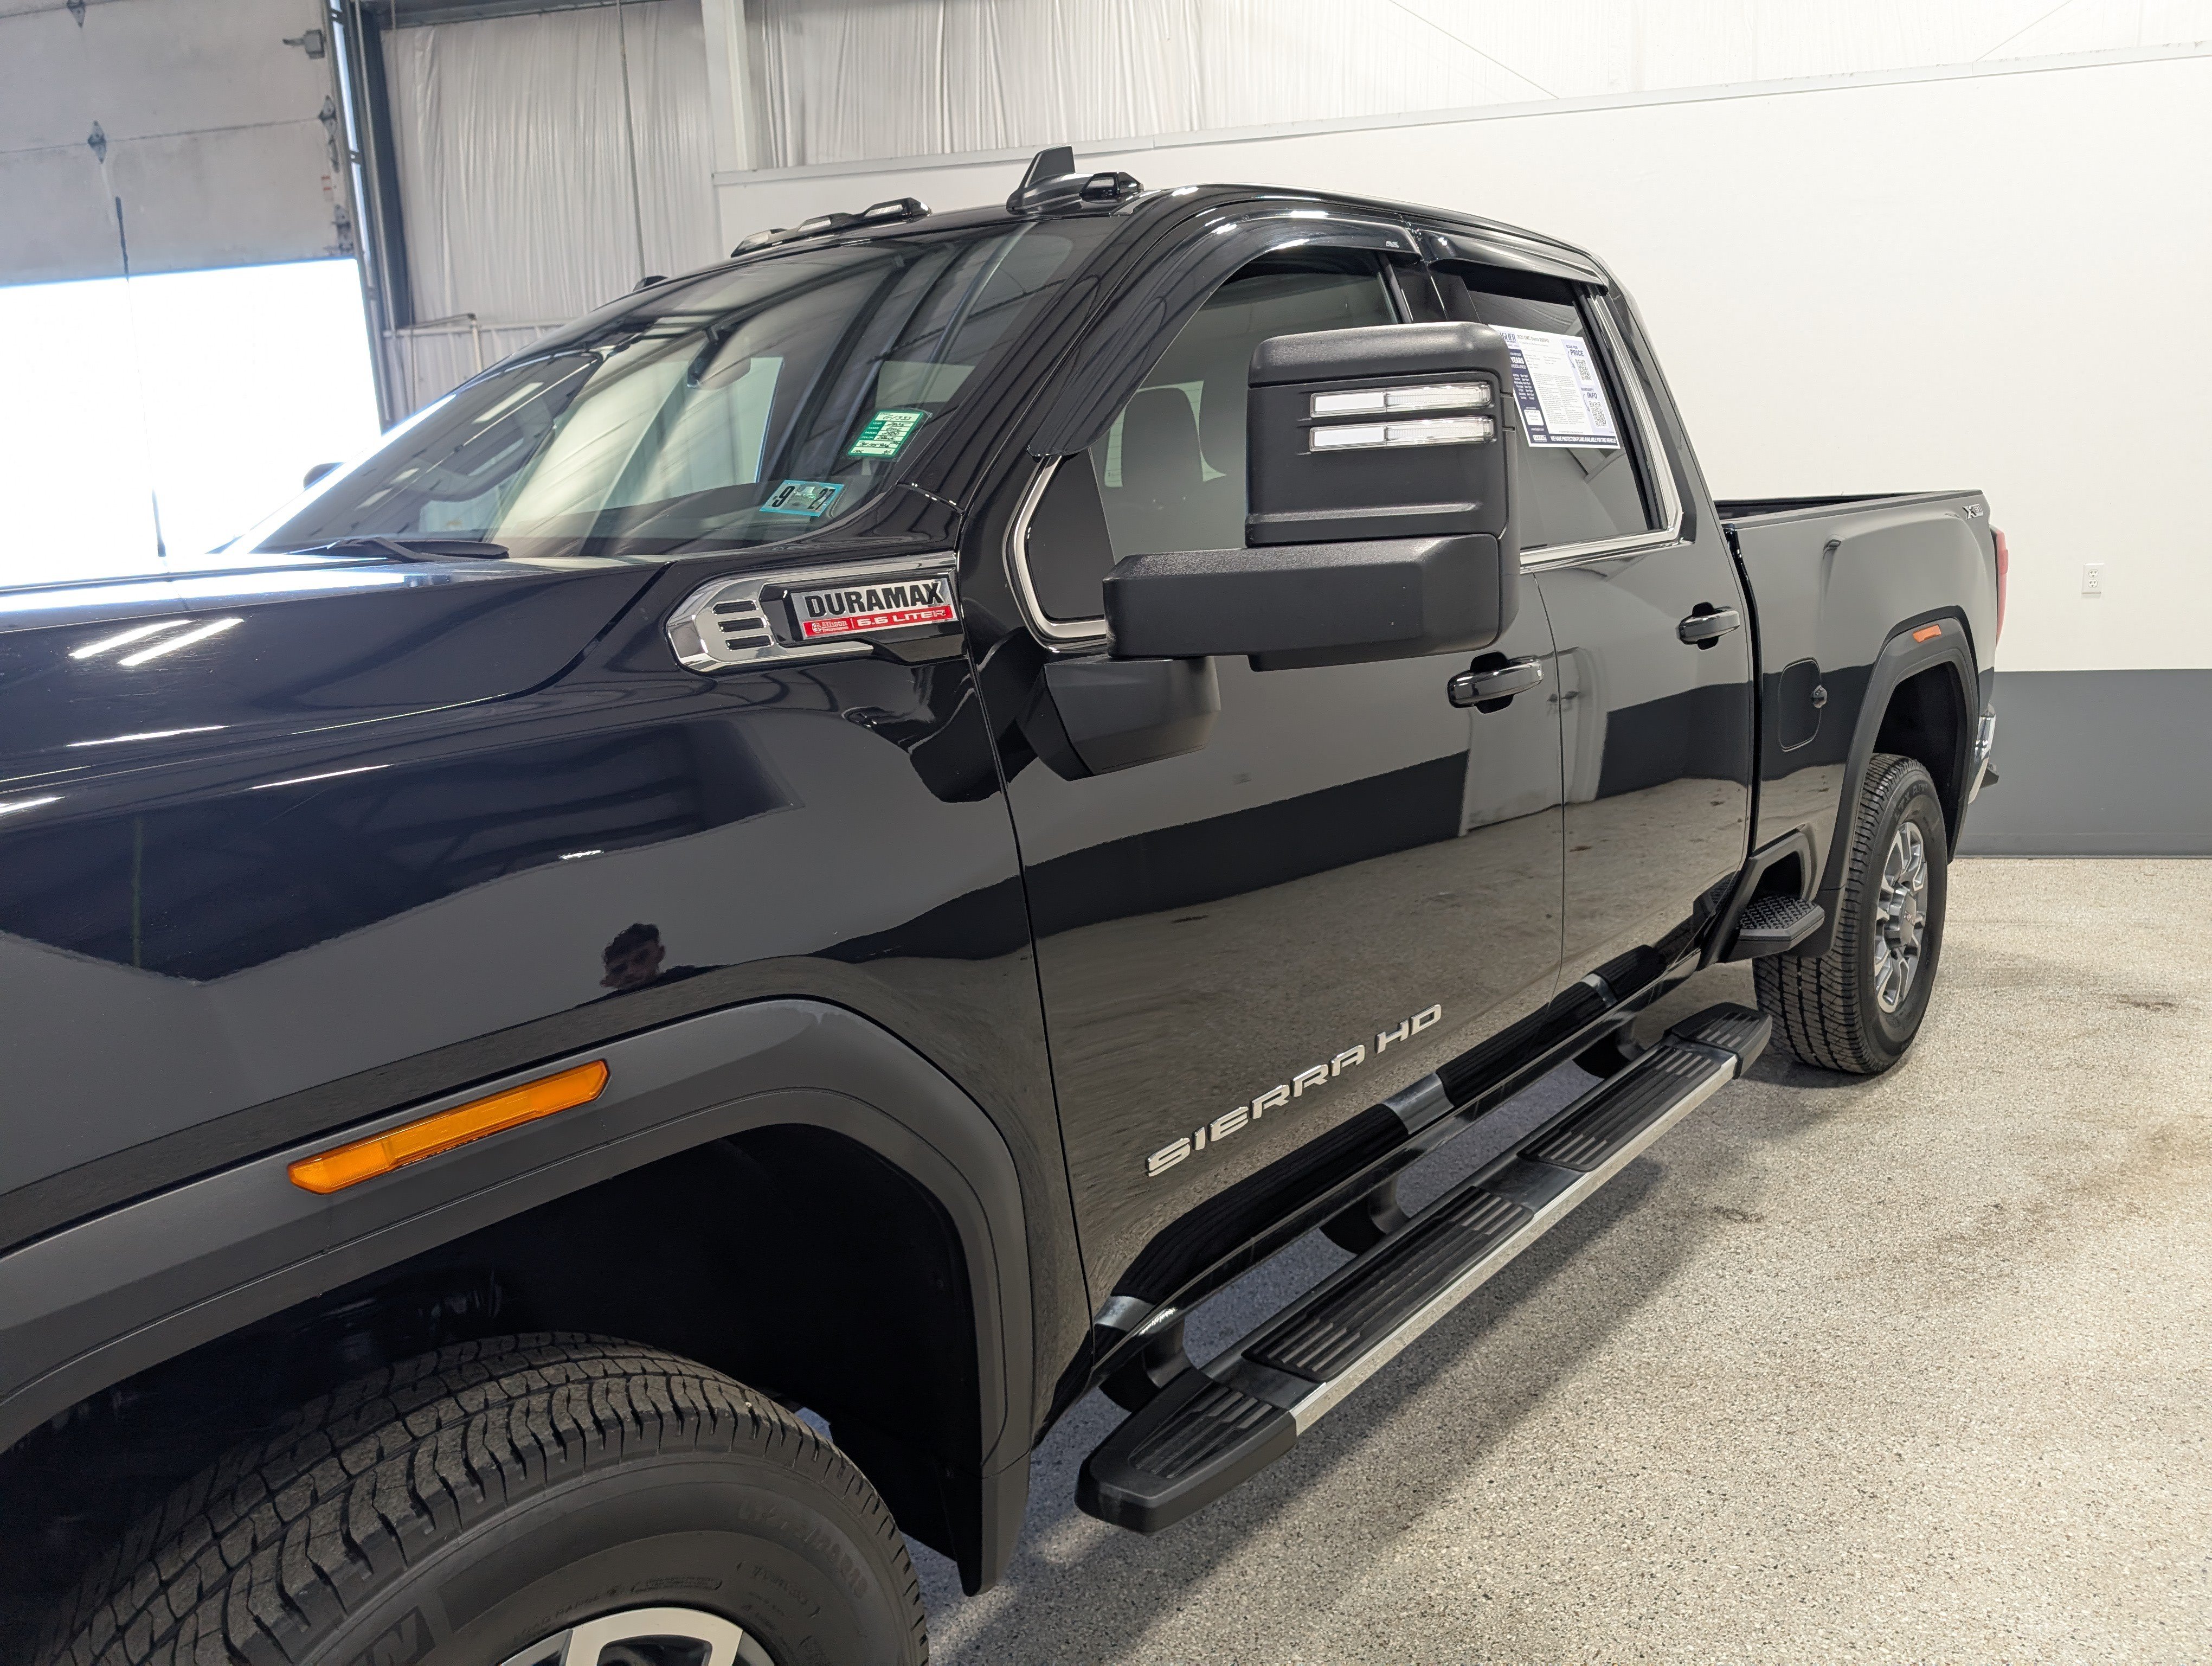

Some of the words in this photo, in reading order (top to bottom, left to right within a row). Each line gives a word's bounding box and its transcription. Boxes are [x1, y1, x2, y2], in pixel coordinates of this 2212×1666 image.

[771, 485, 796, 508] 9
[807, 488, 837, 510] 27
[805, 582, 944, 618] DURAMAX
[857, 617, 889, 627] 6.6
[892, 609, 947, 623] LITER
[1146, 1044, 1365, 1177] SIERRA
[1374, 1004, 1442, 1054] HD
